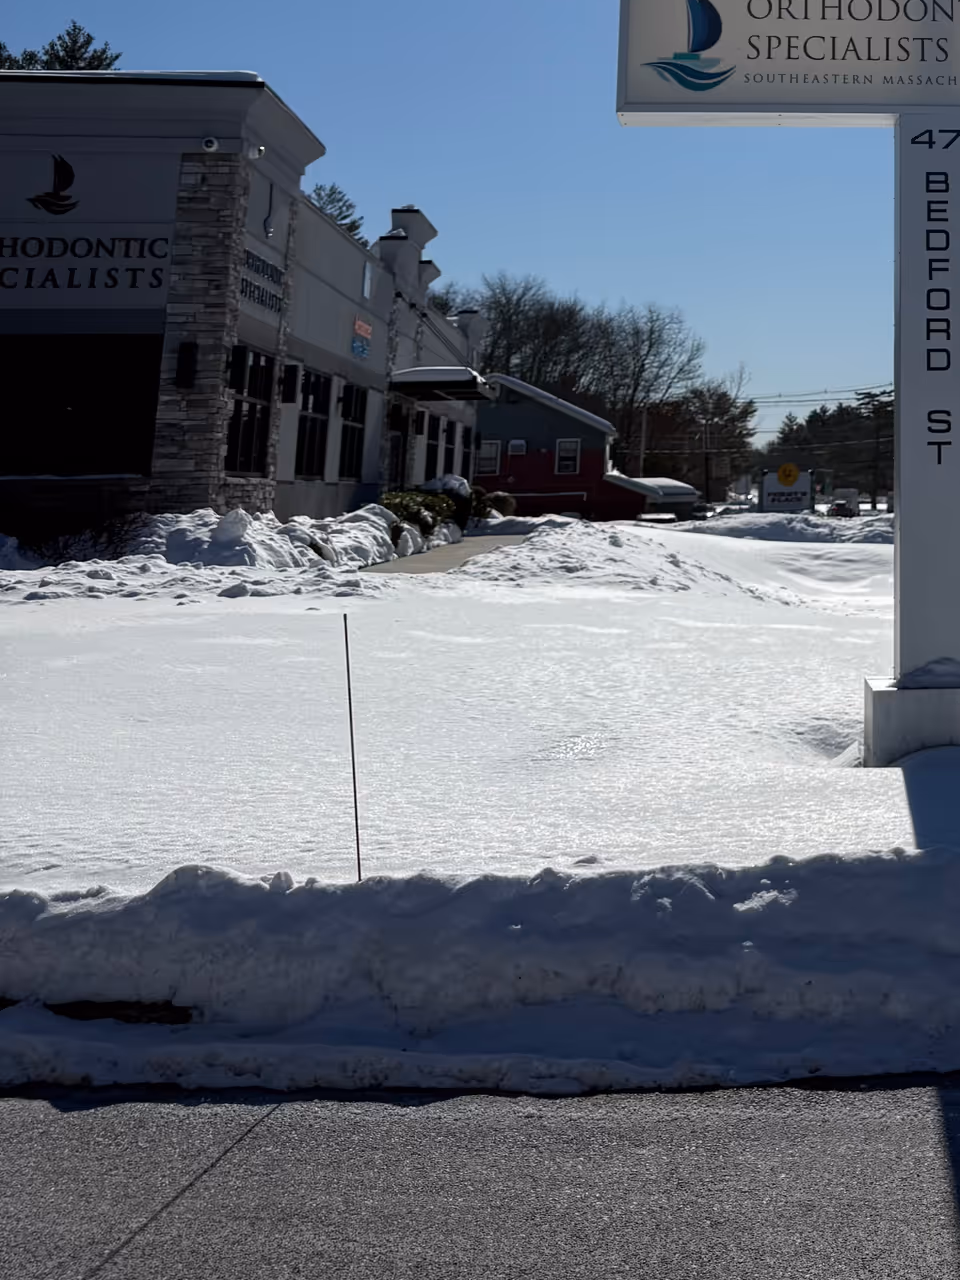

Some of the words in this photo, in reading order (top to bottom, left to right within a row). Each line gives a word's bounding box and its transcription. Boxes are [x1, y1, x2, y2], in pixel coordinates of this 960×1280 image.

[746, 34, 950, 63] SPECIALISTS
[743, 72, 873, 85] SOUTHEASTERN
[0, 237, 169, 258] HODONTIC
[0, 267, 164, 289] CIALISTS
[925, 171, 951, 371] BEDFORD
[926, 409, 952, 465] ST
